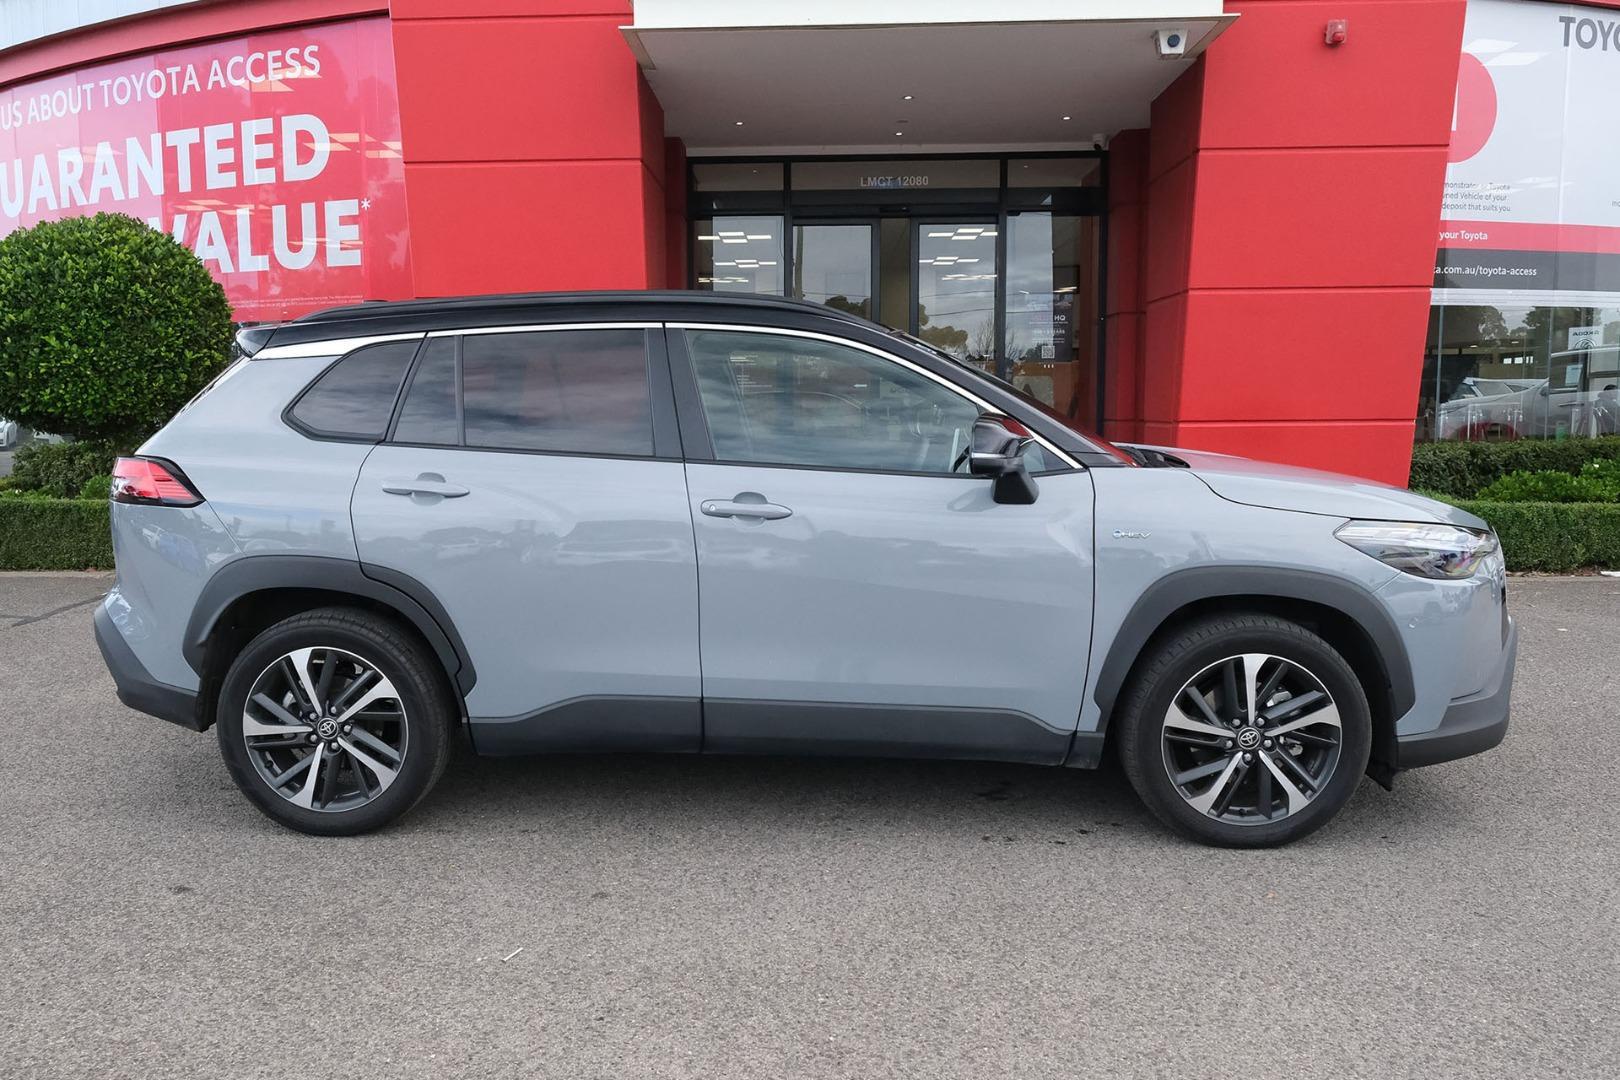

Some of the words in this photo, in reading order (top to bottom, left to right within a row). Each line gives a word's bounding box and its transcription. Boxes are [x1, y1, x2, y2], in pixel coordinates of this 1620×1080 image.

[1, 100, 23, 130] US
[27, 82, 95, 125] ABOUT
[100, 63, 201, 108] TOYOTA
[207, 45, 320, 90] ACCESS
[0, 113, 331, 218] UARANTEED
[897, 175, 929, 186] 12080
[1468, 203, 1481, 211] that
[1439, 231, 1459, 241] your
[1460, 230, 1488, 242] Toyota
